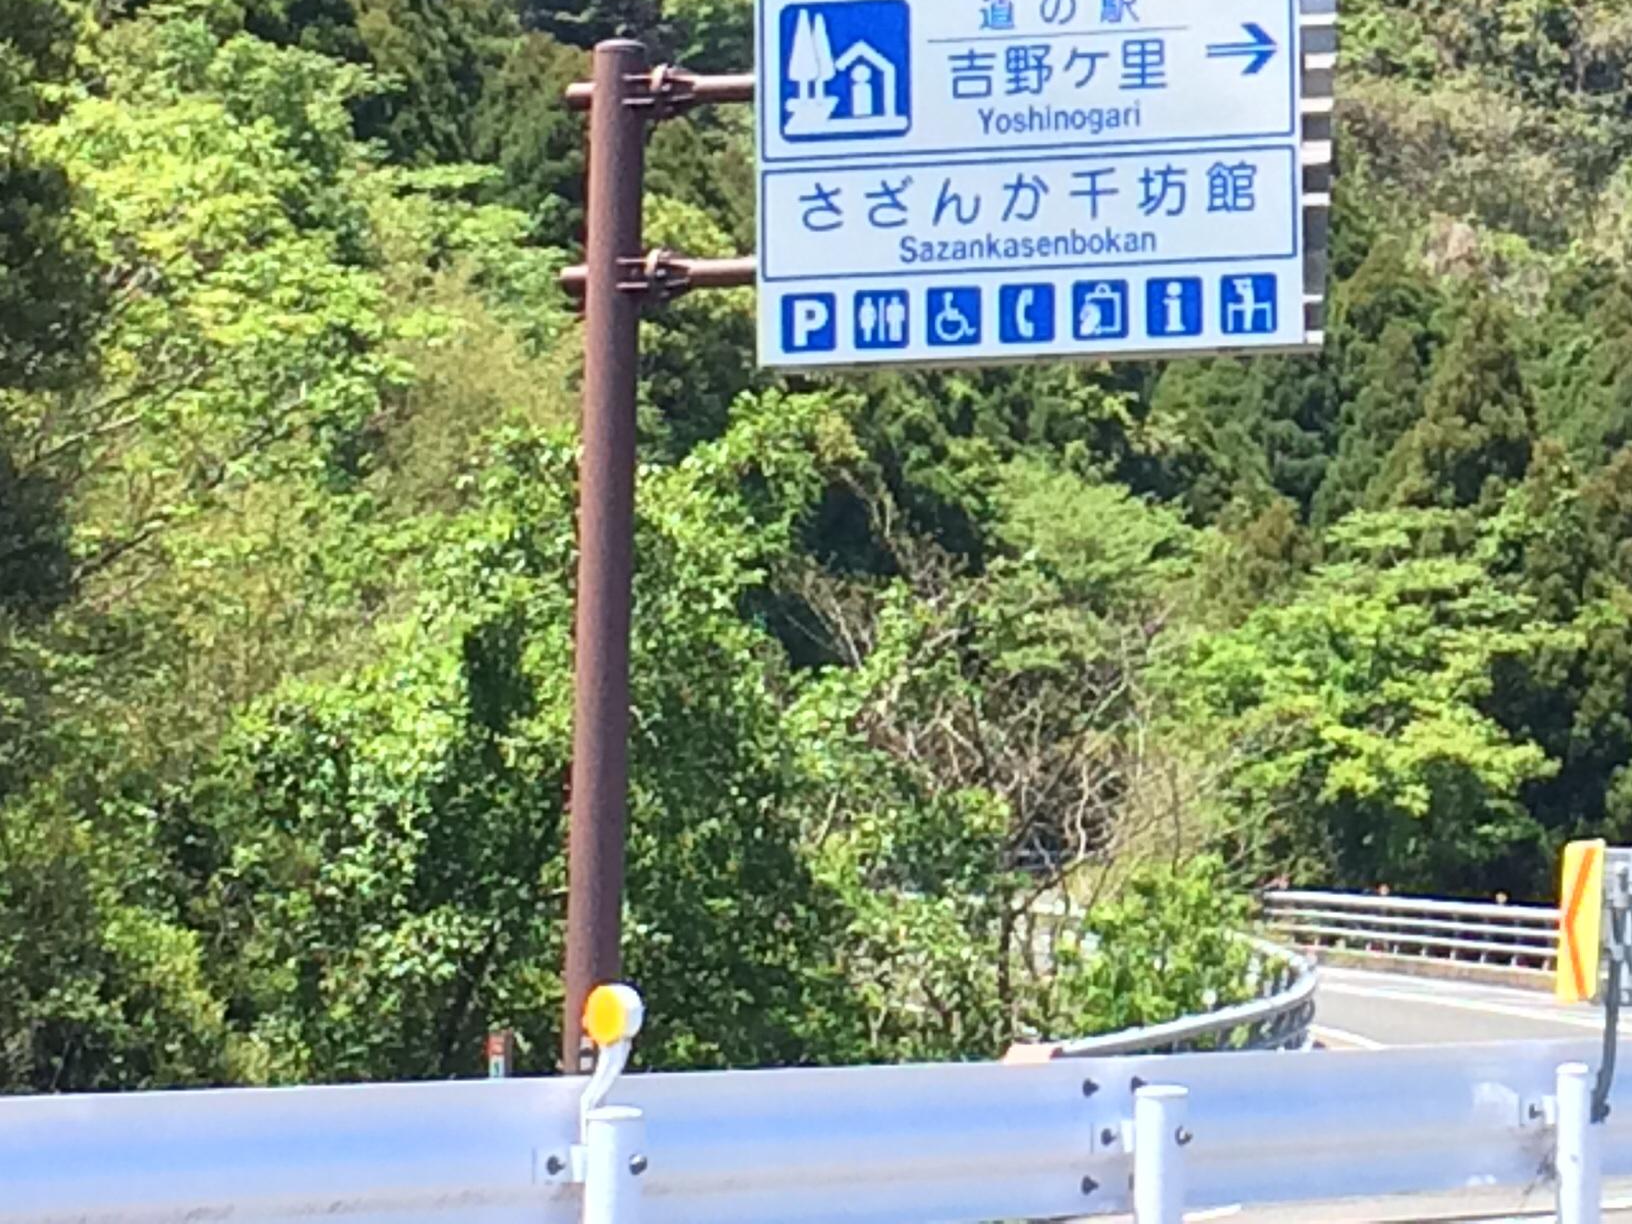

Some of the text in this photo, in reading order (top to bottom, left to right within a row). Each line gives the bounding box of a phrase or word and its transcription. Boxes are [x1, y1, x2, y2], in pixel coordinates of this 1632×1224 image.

[977, 99, 1141, 136] Yoshinogari
[798, 160, 1258, 232] さざんか千坊館
[898, 226, 1158, 264] Sazankasenbokan
[793, 299, 829, 347] P
